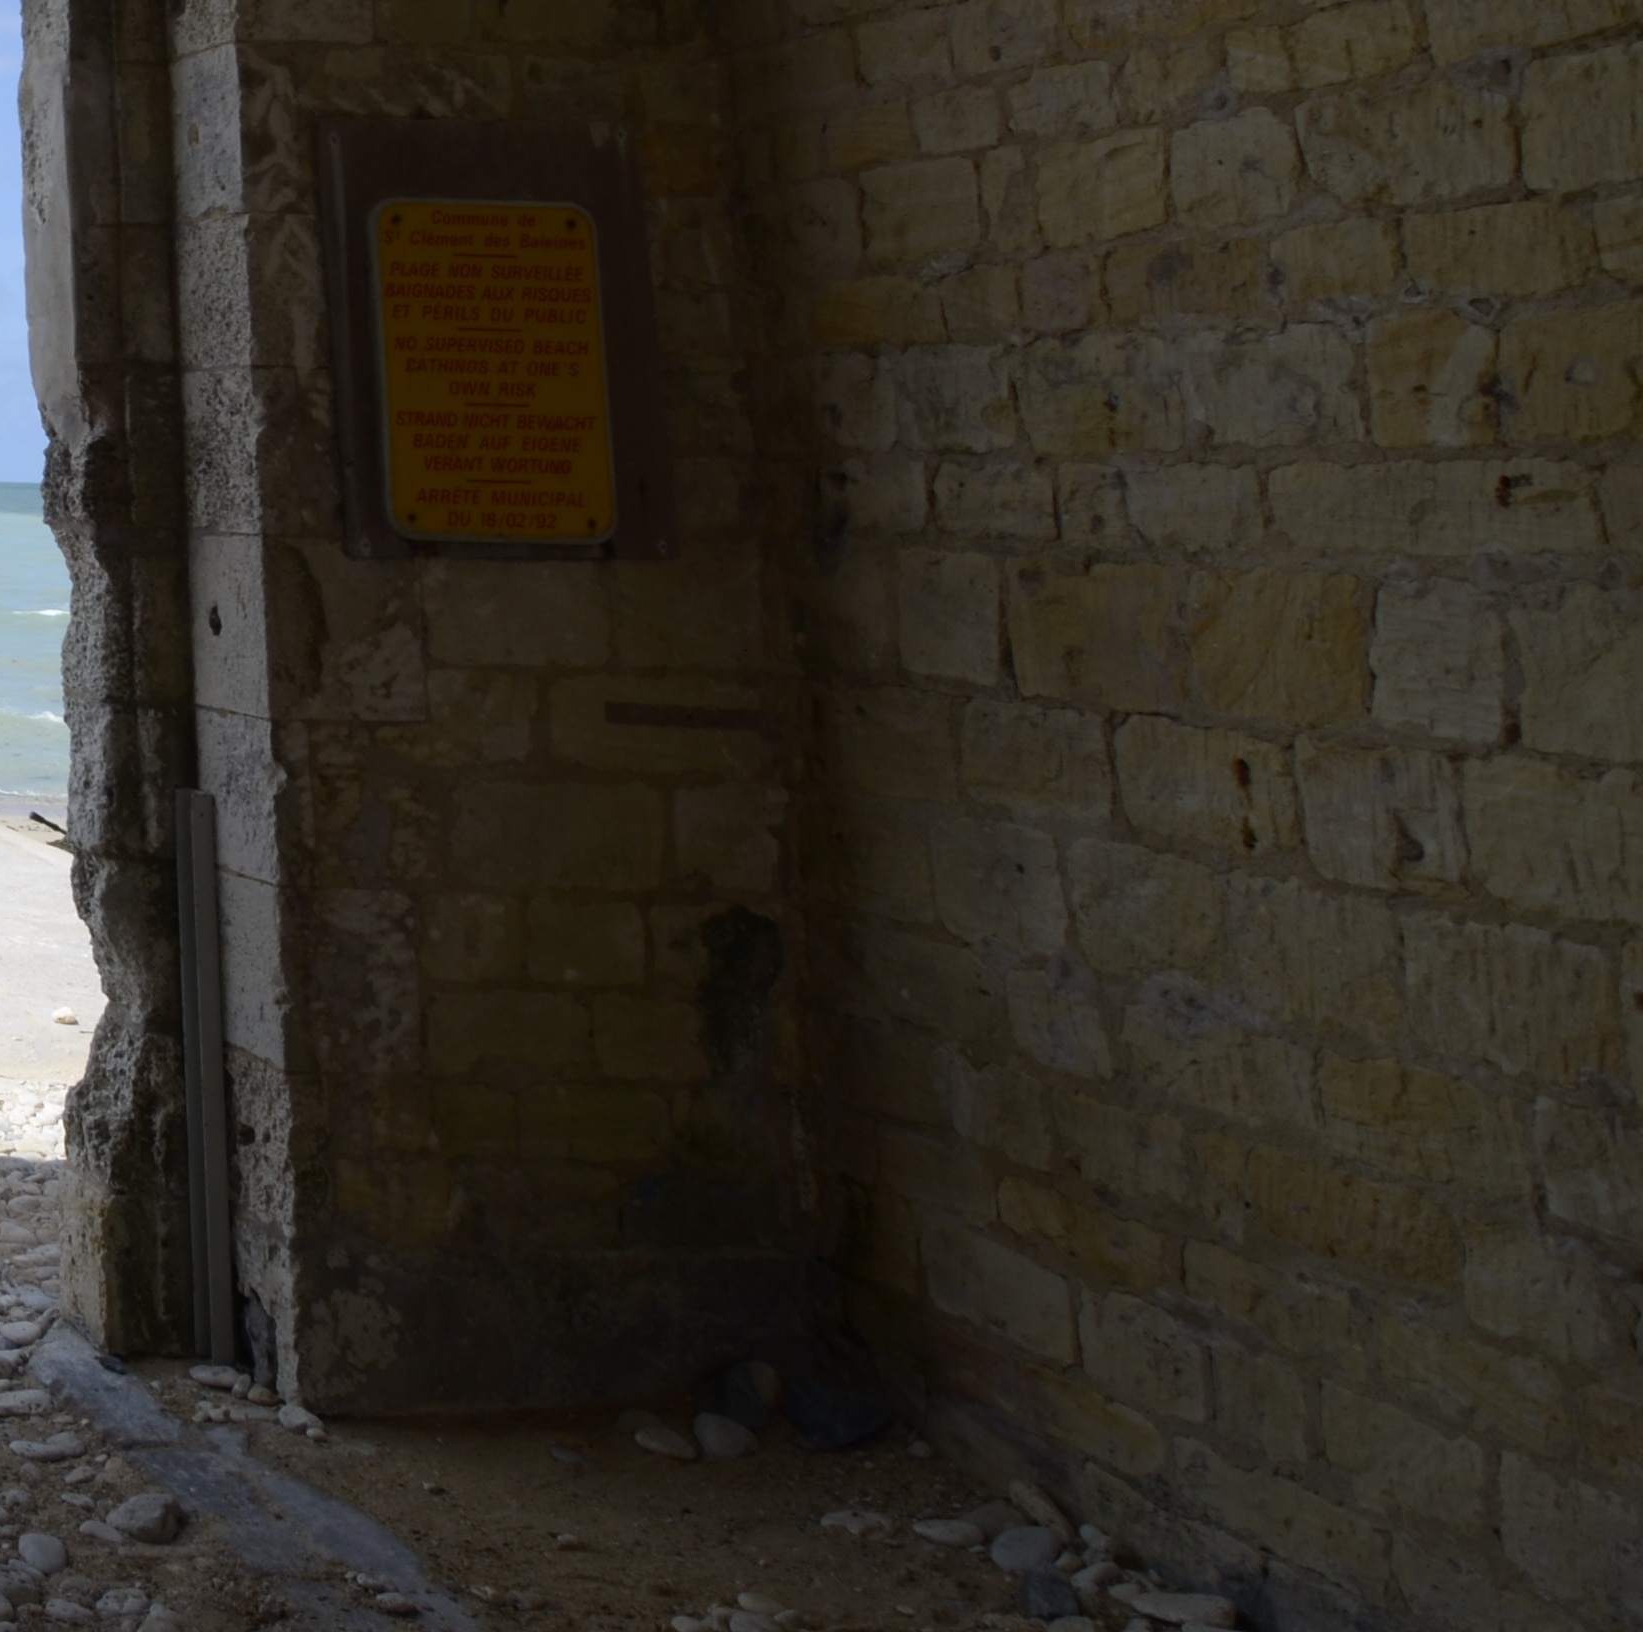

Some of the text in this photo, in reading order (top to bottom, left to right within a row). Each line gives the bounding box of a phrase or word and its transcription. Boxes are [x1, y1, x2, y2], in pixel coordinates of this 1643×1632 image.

[431, 210, 536, 228] Commune de
[483, 234, 511, 248] des
[519, 234, 587, 250] Baleines
[389, 260, 584, 282] PLAGE NON SURVEILLÉE
[384, 282, 592, 303] BAIGNADES AUX RISQUES
[392, 303, 588, 324] ET PÉRILS DU PUBLIC
[394, 336, 589, 356] NO SUPERVISED BEACH
[497, 360, 519, 375] AT
[449, 381, 537, 398] OWN RISK
[396, 411, 597, 431] STRAND NICHT BEWACHT
[413, 433, 583, 453] BADEN AUF EIGENE
[491, 490, 586, 508] MUNICIPAL
[447, 511, 471, 527] DU
